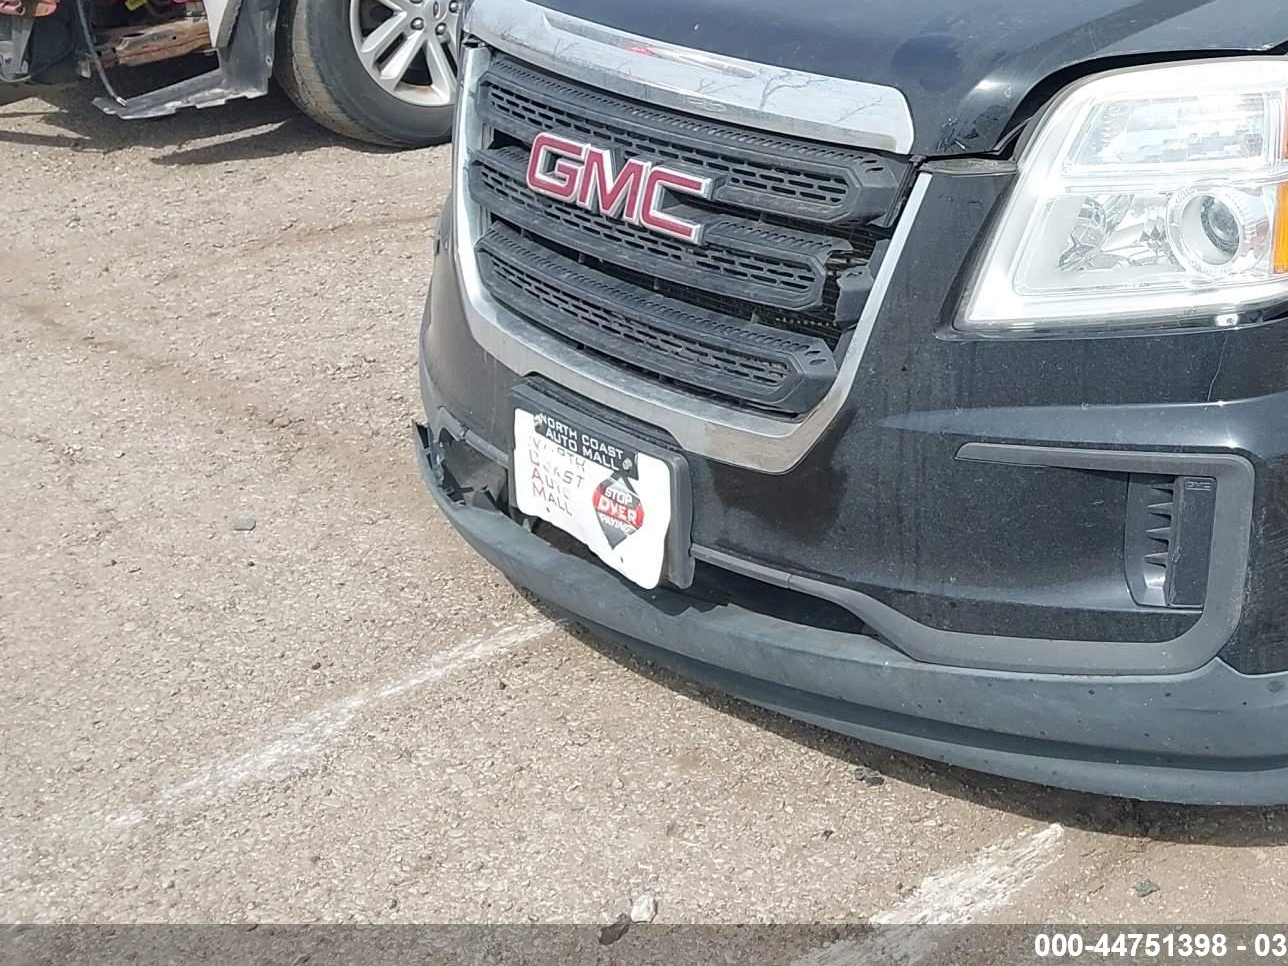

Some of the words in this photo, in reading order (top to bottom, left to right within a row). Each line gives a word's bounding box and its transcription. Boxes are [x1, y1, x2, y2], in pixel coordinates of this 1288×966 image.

[526, 132, 714, 245] GMC
[539, 413, 578, 440] NORTH
[581, 434, 624, 460] COAST
[545, 427, 578, 453] AUTO
[582, 445, 621, 472] MALL
[604, 486, 634, 507] STOP
